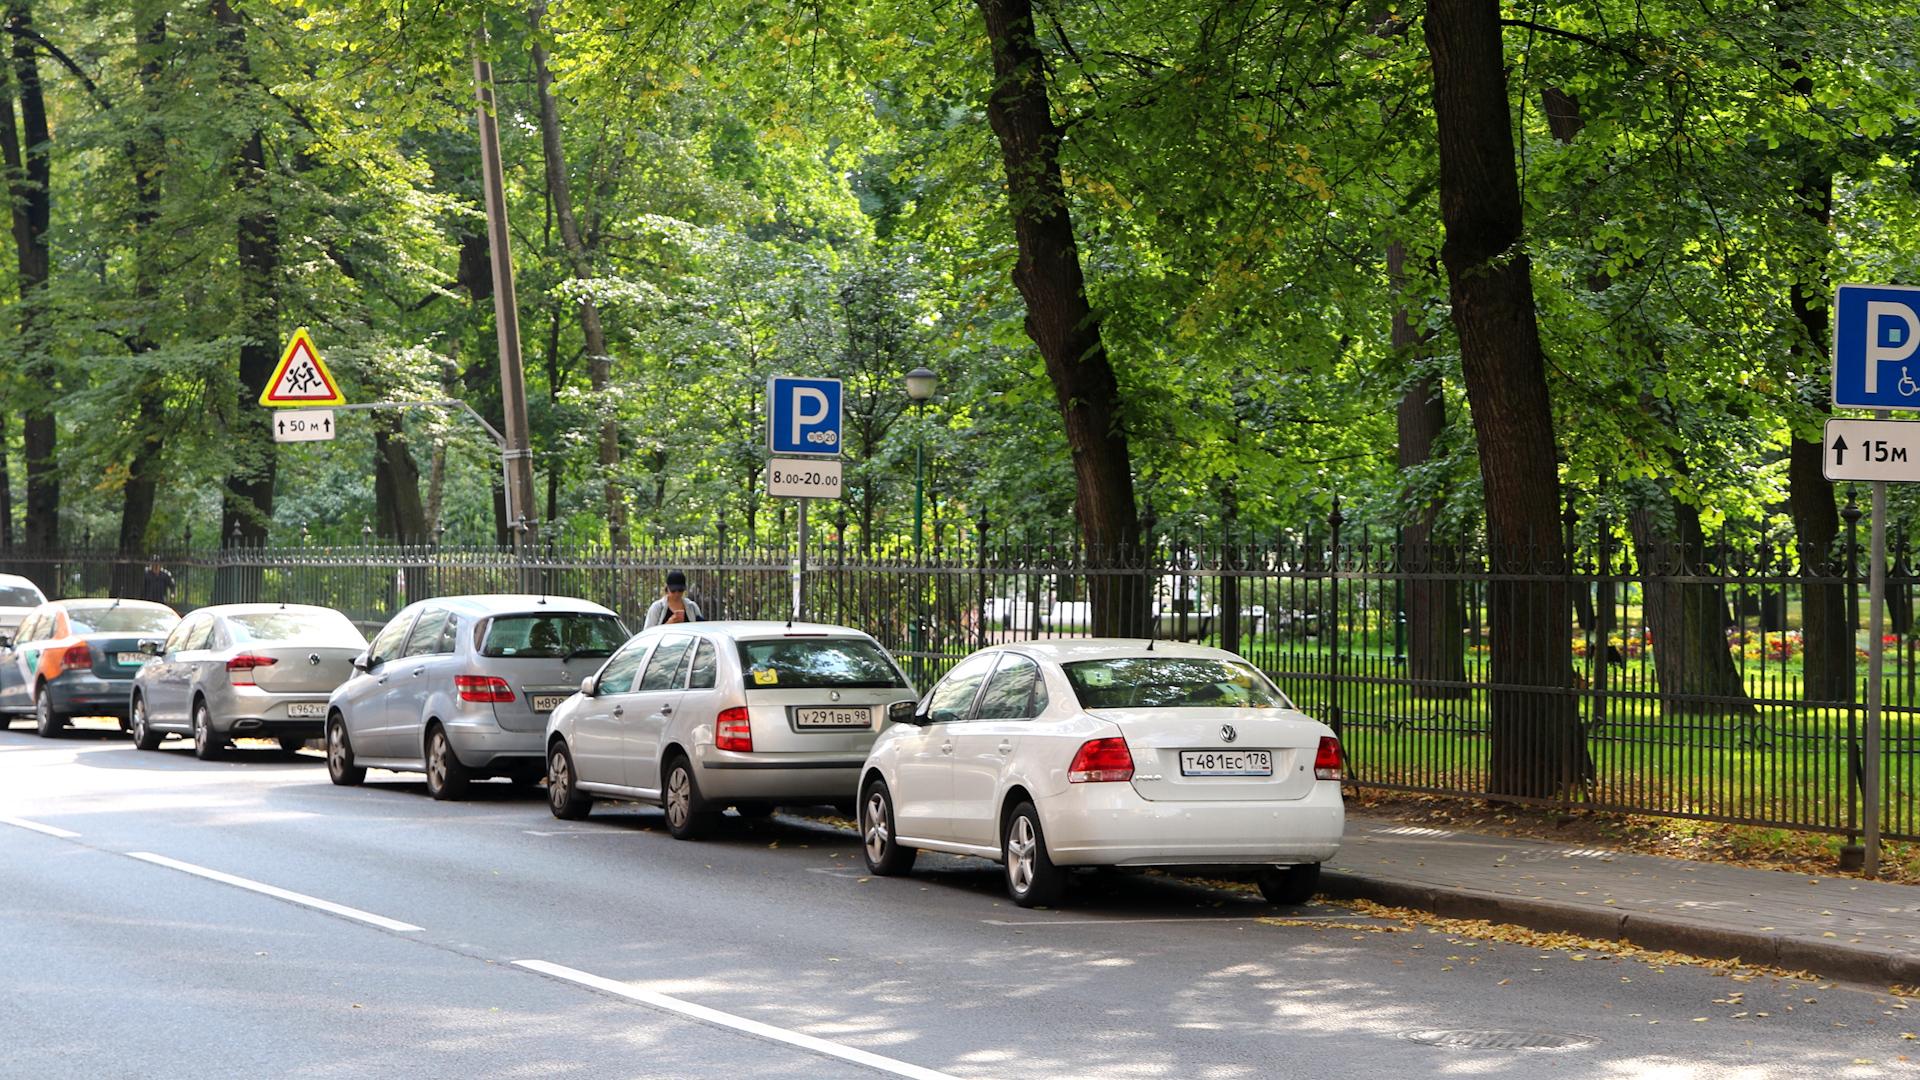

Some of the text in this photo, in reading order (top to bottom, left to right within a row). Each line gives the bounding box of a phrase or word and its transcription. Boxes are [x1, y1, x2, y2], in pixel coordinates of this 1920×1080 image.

[1865, 301, 1920, 394] P
[791, 386, 829, 445] P
[290, 420, 305, 431] 50
[773, 471, 838, 486] 8.00-20.00
[854, 710, 867, 720] 98
[1246, 753, 1267, 765] 178
